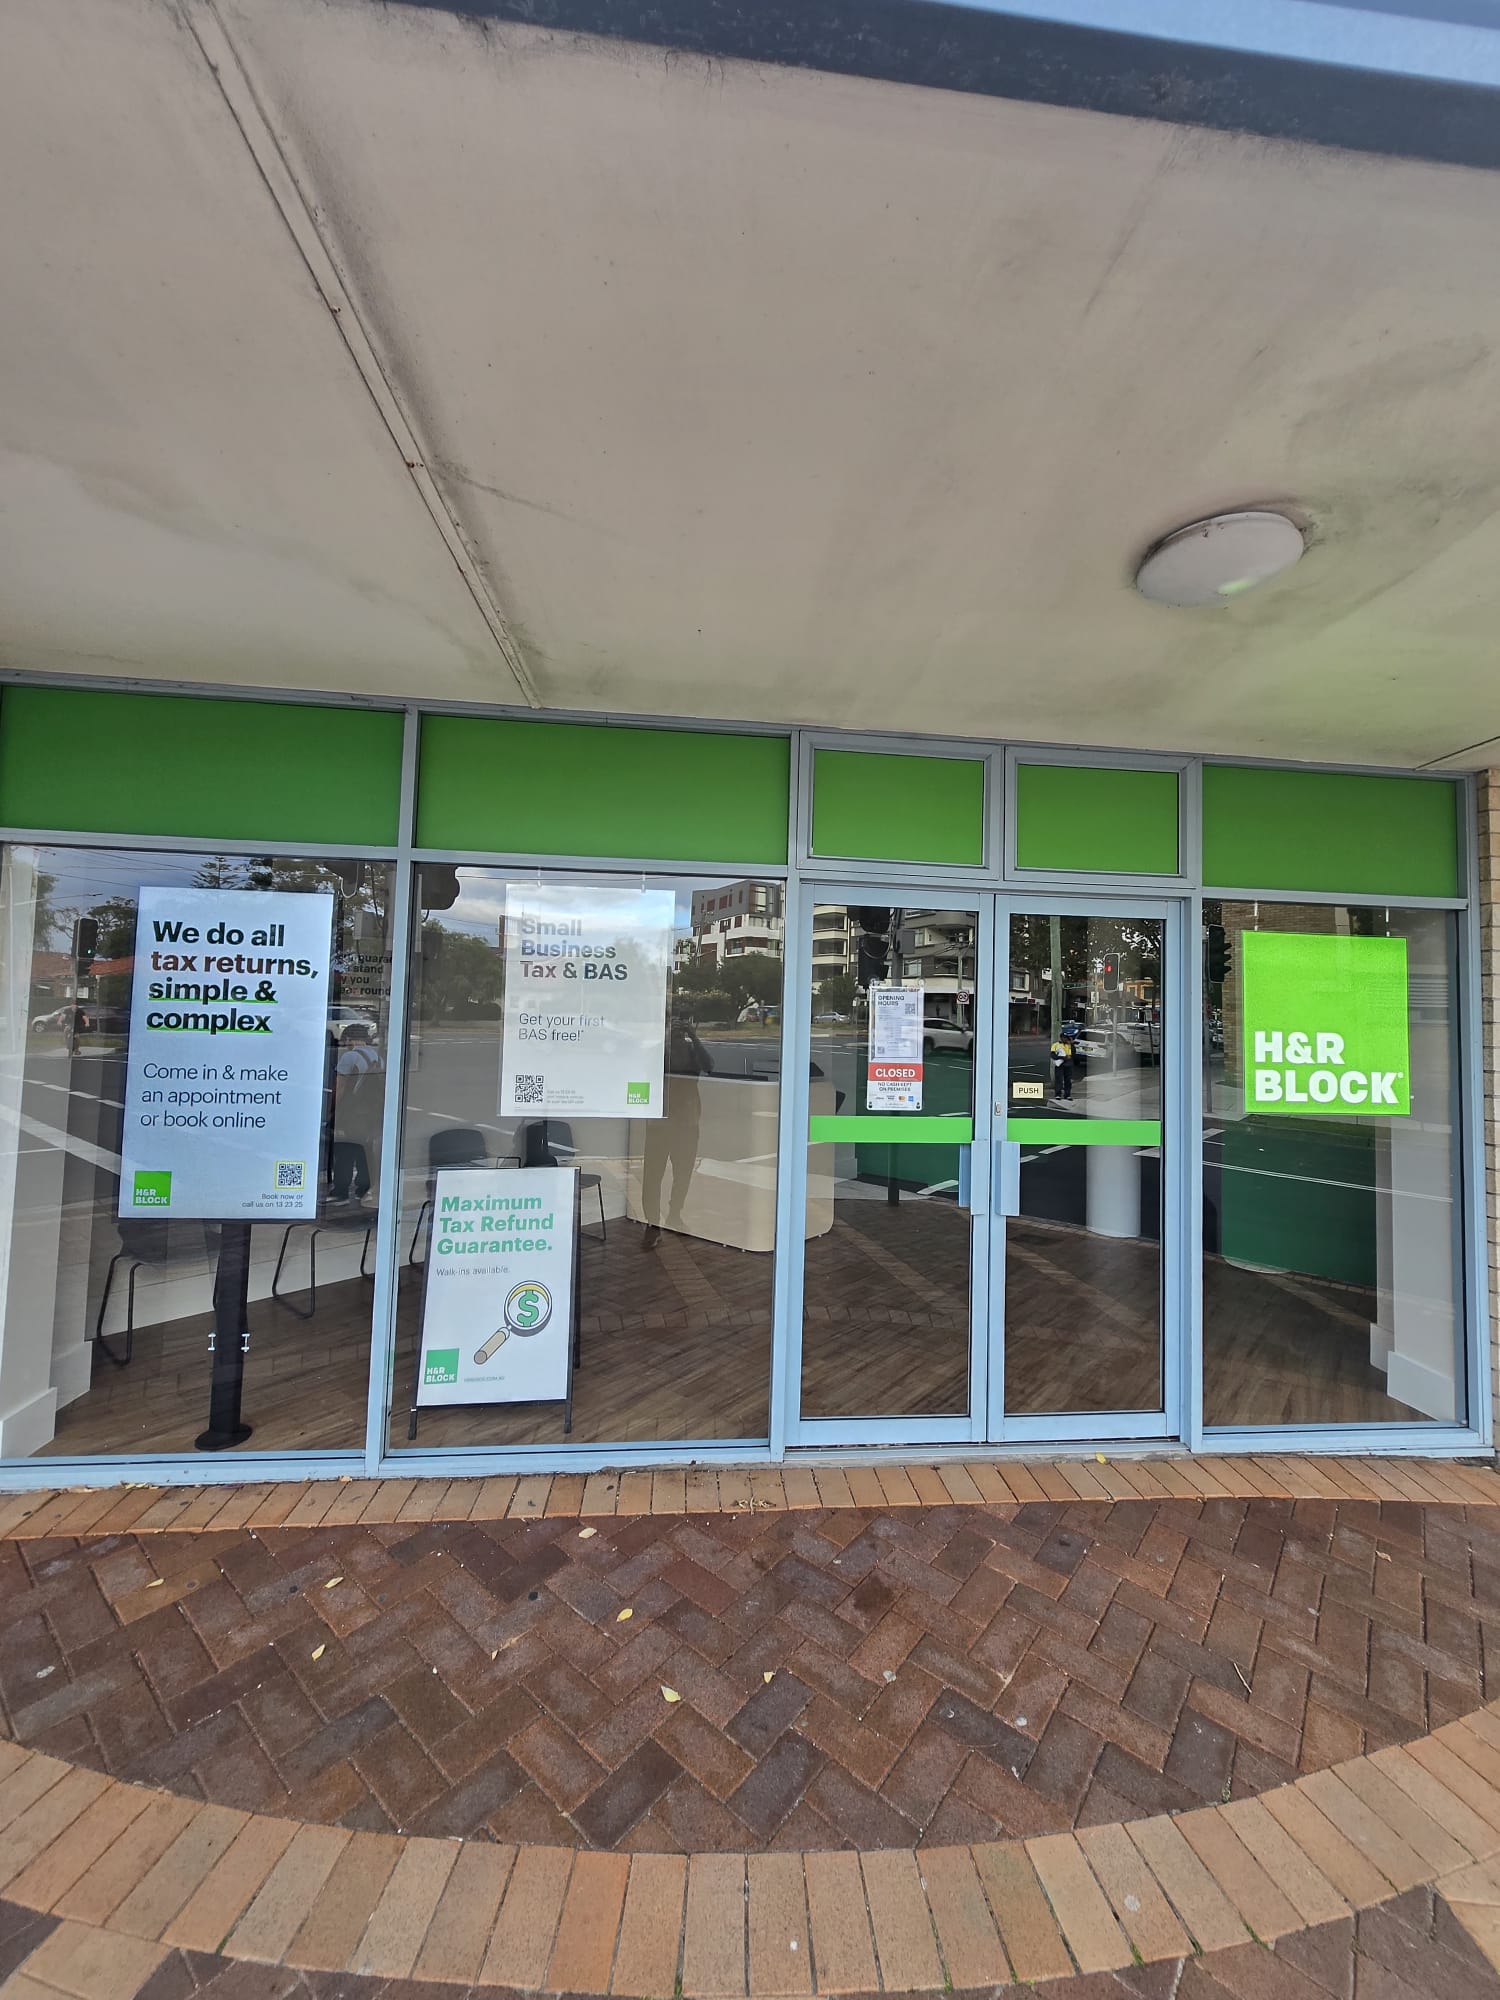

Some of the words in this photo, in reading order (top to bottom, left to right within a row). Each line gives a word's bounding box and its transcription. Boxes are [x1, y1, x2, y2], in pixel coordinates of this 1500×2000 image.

[153, 921, 200, 943] We
[206, 922, 244, 945] do
[251, 924, 285, 947] all
[521, 917, 582, 937] Small
[521, 939, 617, 958] Business
[151, 950, 197, 973] tax
[204, 953, 319, 979] returns,
[353, 965, 384, 974] stand
[520, 961, 557, 979] Tax
[562, 962, 578, 980] &
[583, 962, 628, 981] BAS
[351, 976, 370, 985] you
[149, 977, 248, 1005] simple
[255, 980, 277, 1002] &
[146, 1008, 272, 1035] complex
[519, 1013, 543, 1026] Get
[546, 1015, 575, 1029] your
[579, 1014, 605, 1026] first
[518, 1028, 548, 1041] BAS
[1255, 1031, 1345, 1065] H&R
[143, 1063, 198, 1081] Come
[202, 1063, 218, 1081] in
[222, 1065, 236, 1081] &
[240, 1065, 288, 1082] make
[875, 1068, 916, 1078] CLOSED
[141, 1090, 163, 1103] an
[168, 1087, 281, 1107] appointment
[140, 1113, 159, 1127] or
[164, 1111, 208, 1127] book
[212, 1112, 266, 1129] online
[135, 1196, 168, 1204] BLOCK
[441, 1195, 542, 1212] Maximum
[439, 1217, 474, 1233] Tax
[481, 1213, 554, 1232] Refund
[437, 1236, 552, 1255] Guarantee.
[436, 1266, 470, 1276] Walk-ins
[425, 1374, 455, 1382] BLOCK
[426, 1366, 446, 1375] H&R
